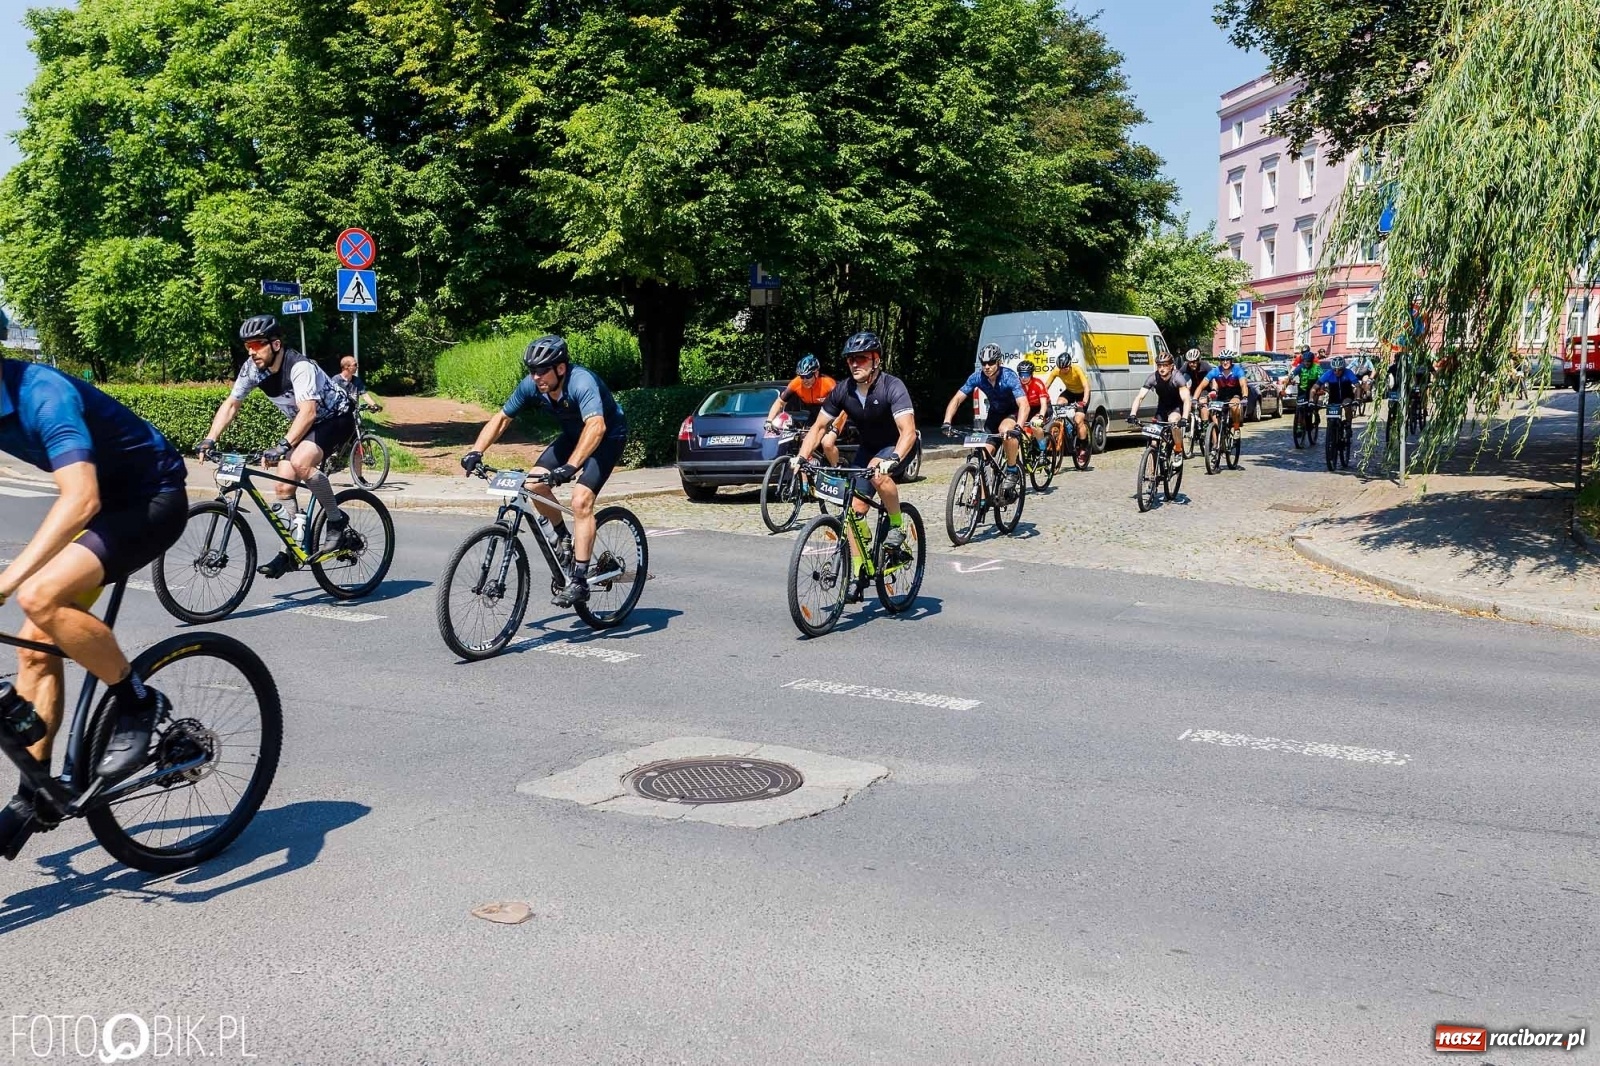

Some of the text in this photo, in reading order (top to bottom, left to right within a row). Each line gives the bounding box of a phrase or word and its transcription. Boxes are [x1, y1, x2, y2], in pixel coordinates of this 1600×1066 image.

[1236, 303, 1248, 318] P
[1034, 365, 1057, 373] BOX
[496, 479, 517, 487] 1435
[820, 482, 839, 495] 2146
